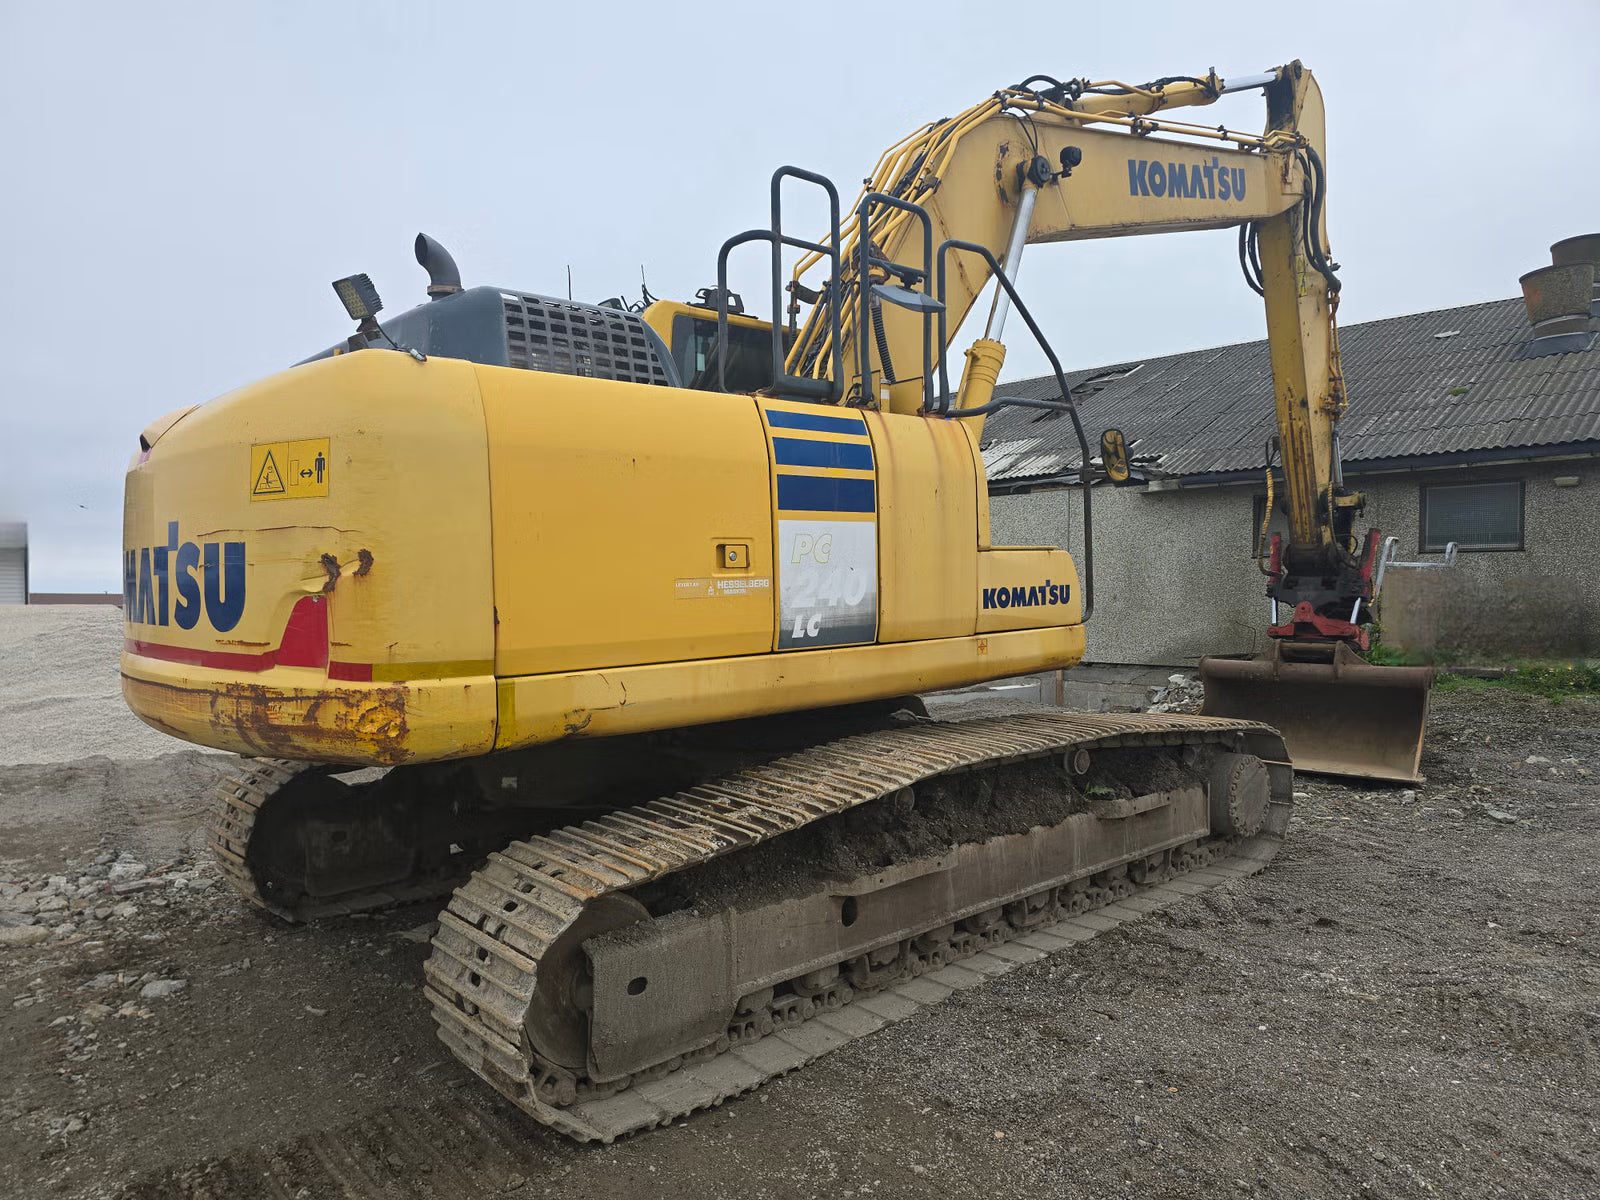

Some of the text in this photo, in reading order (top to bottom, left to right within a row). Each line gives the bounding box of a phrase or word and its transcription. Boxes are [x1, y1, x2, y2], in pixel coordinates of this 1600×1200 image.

[1127, 156, 1246, 202] KOMATSU
[791, 534, 833, 564] PC
[123, 520, 247, 633] MATSU
[717, 579, 769, 589] HESSELBERG
[982, 579, 1071, 609] KOMATSU
[791, 613, 822, 639] LC
